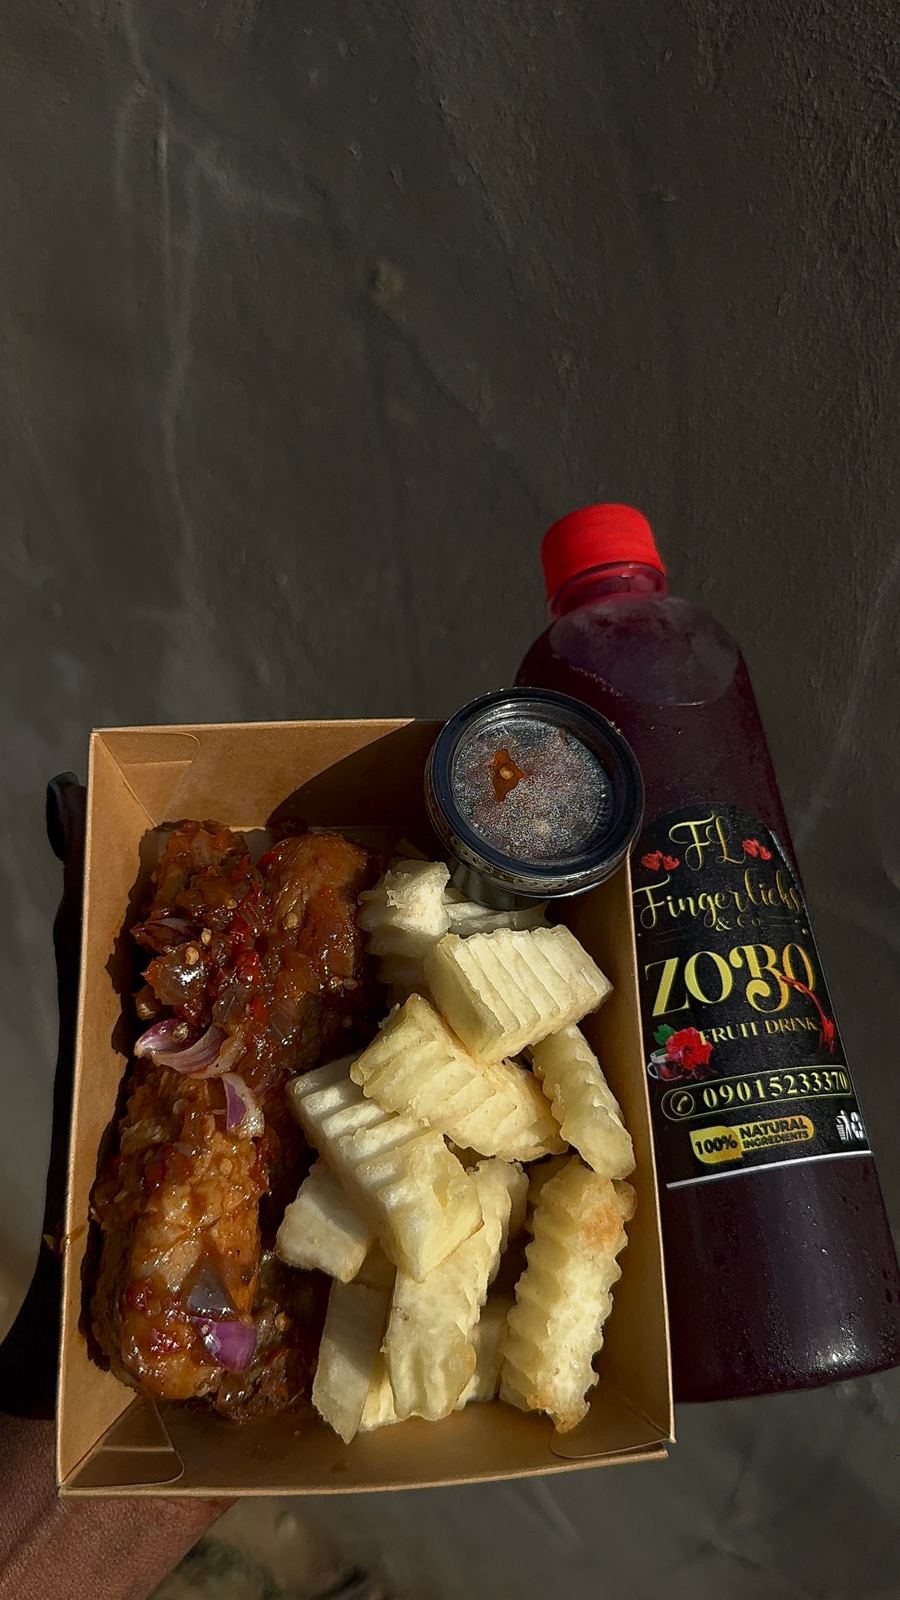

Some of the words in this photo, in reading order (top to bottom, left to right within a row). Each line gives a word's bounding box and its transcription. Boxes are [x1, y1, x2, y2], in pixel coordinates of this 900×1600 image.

[715, 916, 732, 932] &
[644, 943, 814, 1016] ZOBO
[699, 1022, 760, 1046] FRUIT
[765, 1016, 820, 1035] DRINK
[703, 1071, 848, 1108] 09015233370
[738, 1116, 808, 1140] NATURAL
[742, 1130, 809, 1149] INGREDIENTS
[694, 1134, 739, 1155] 100%
